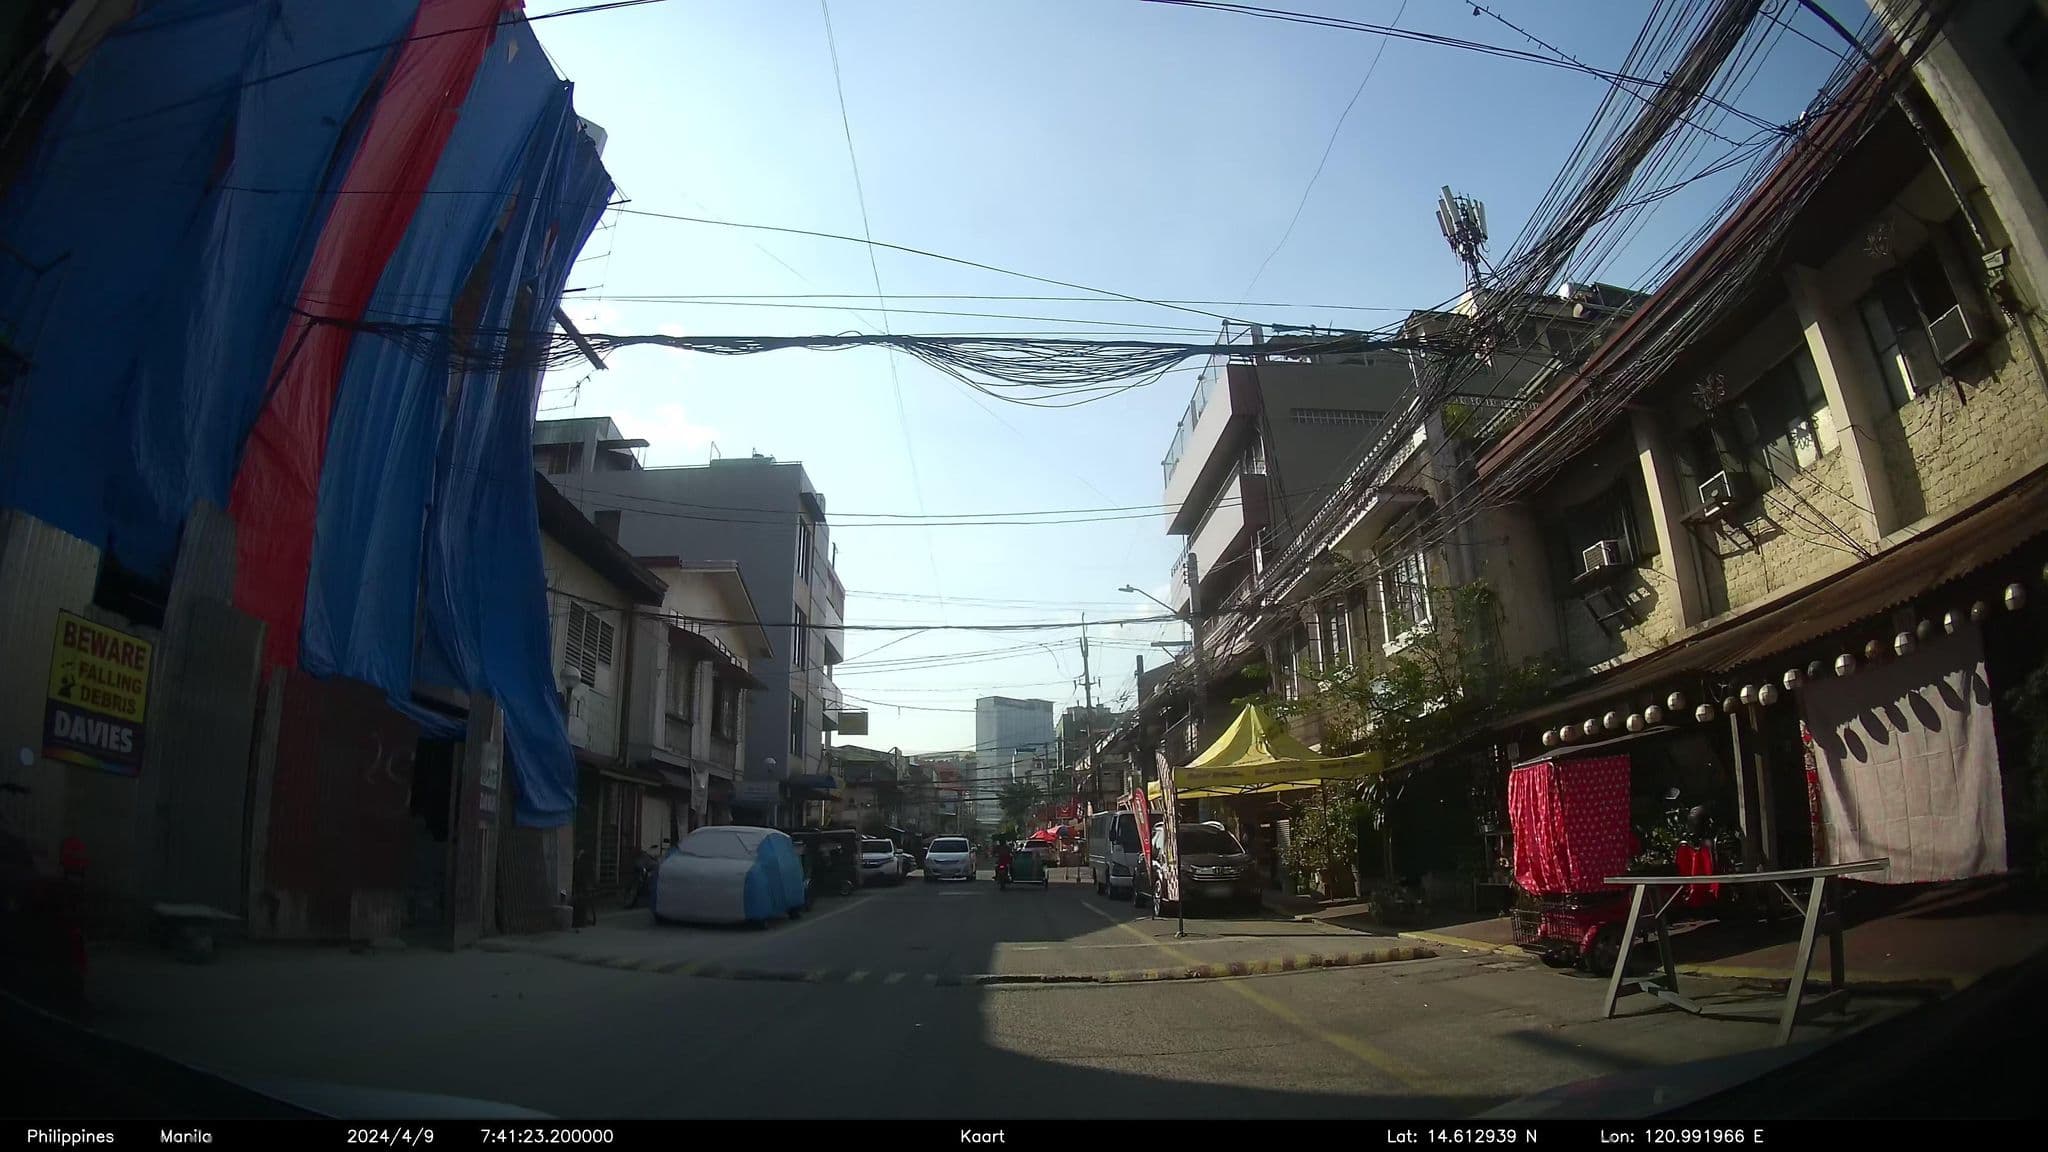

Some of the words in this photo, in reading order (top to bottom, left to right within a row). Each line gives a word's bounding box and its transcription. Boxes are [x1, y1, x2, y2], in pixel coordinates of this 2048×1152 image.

[63, 621, 146, 671] BEWARE
[79, 661, 142, 695] FALLING
[80, 685, 136, 714] DEBRIS
[54, 709, 133, 753] DAVIES
